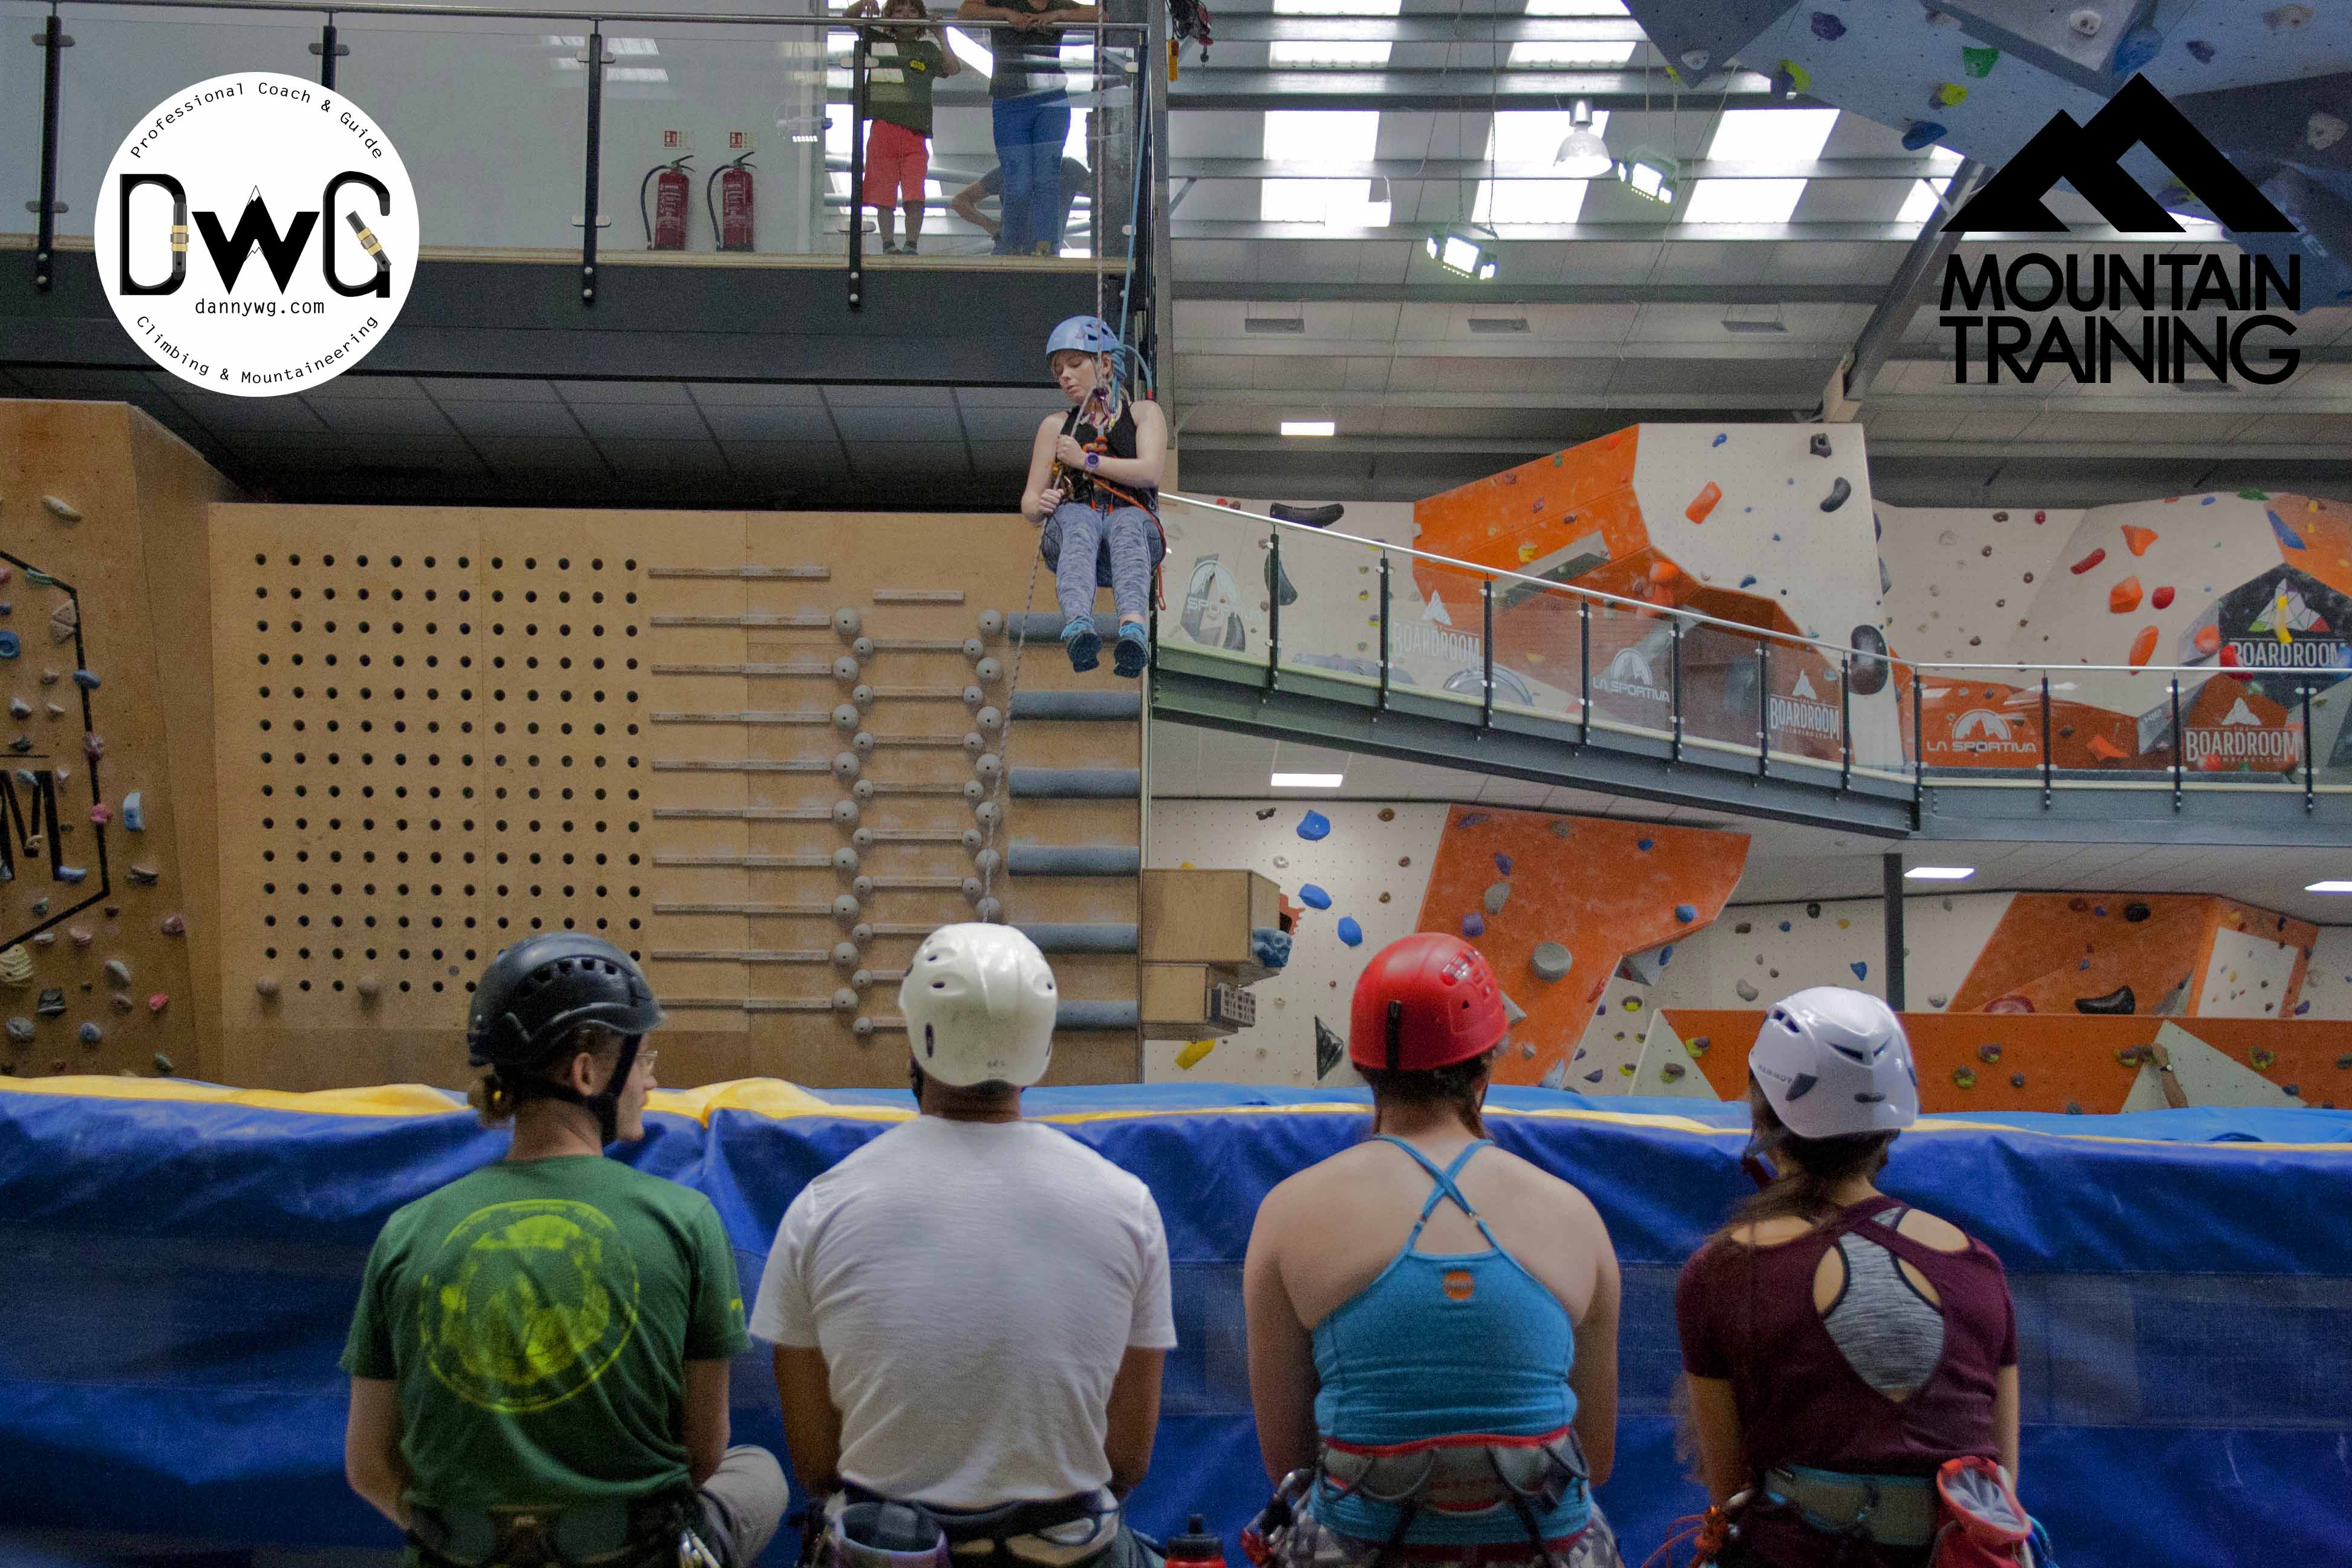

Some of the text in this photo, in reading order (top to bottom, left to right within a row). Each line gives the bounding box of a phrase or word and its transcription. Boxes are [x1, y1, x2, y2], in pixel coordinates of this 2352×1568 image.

[1593, 677, 1671, 703] LA SPORTIVA
[1770, 697, 1840, 740] BOARDROOM
[1926, 740, 2037, 753] LA SPORTIVA
[2186, 730, 2299, 762] BOARDROOM
